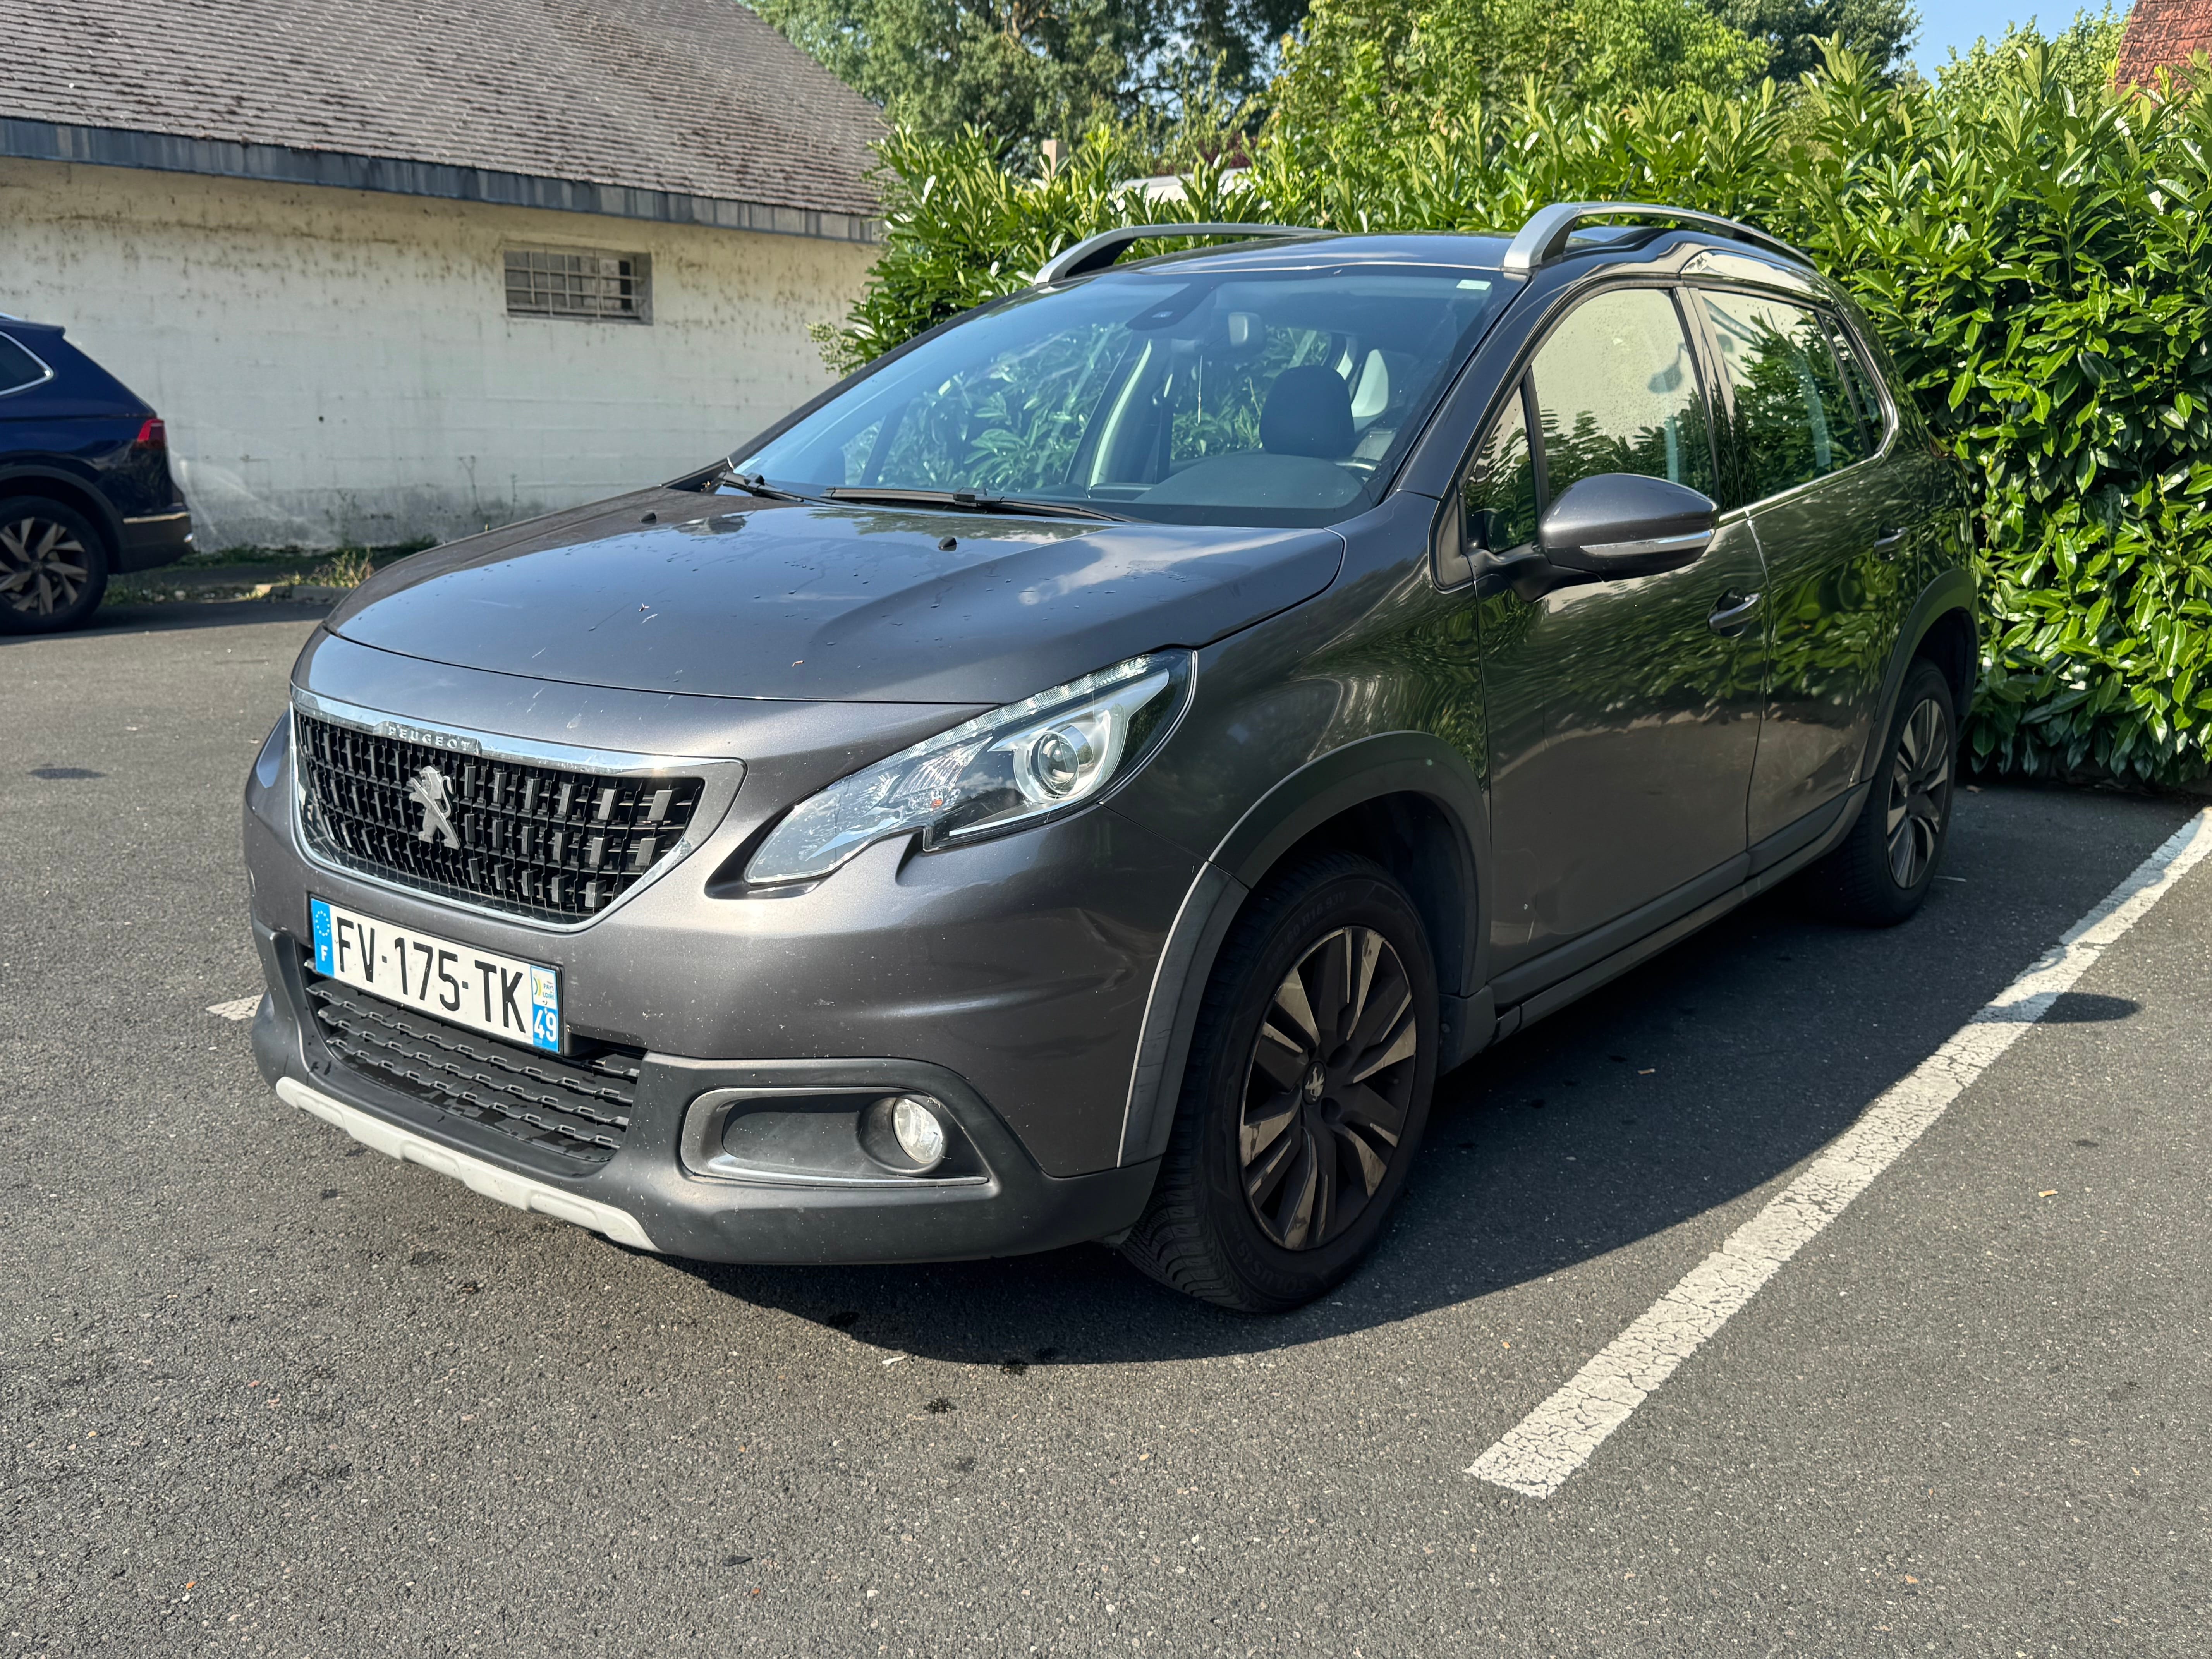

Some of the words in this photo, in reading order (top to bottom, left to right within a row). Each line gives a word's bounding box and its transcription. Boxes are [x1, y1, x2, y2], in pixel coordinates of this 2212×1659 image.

[388, 726, 470, 750] PEUGEOT
[321, 945, 328, 961] F
[337, 916, 526, 1034] FV-175-TK
[534, 1009, 557, 1042] 49
[1250, 1261, 1309, 1292] SOLUS
